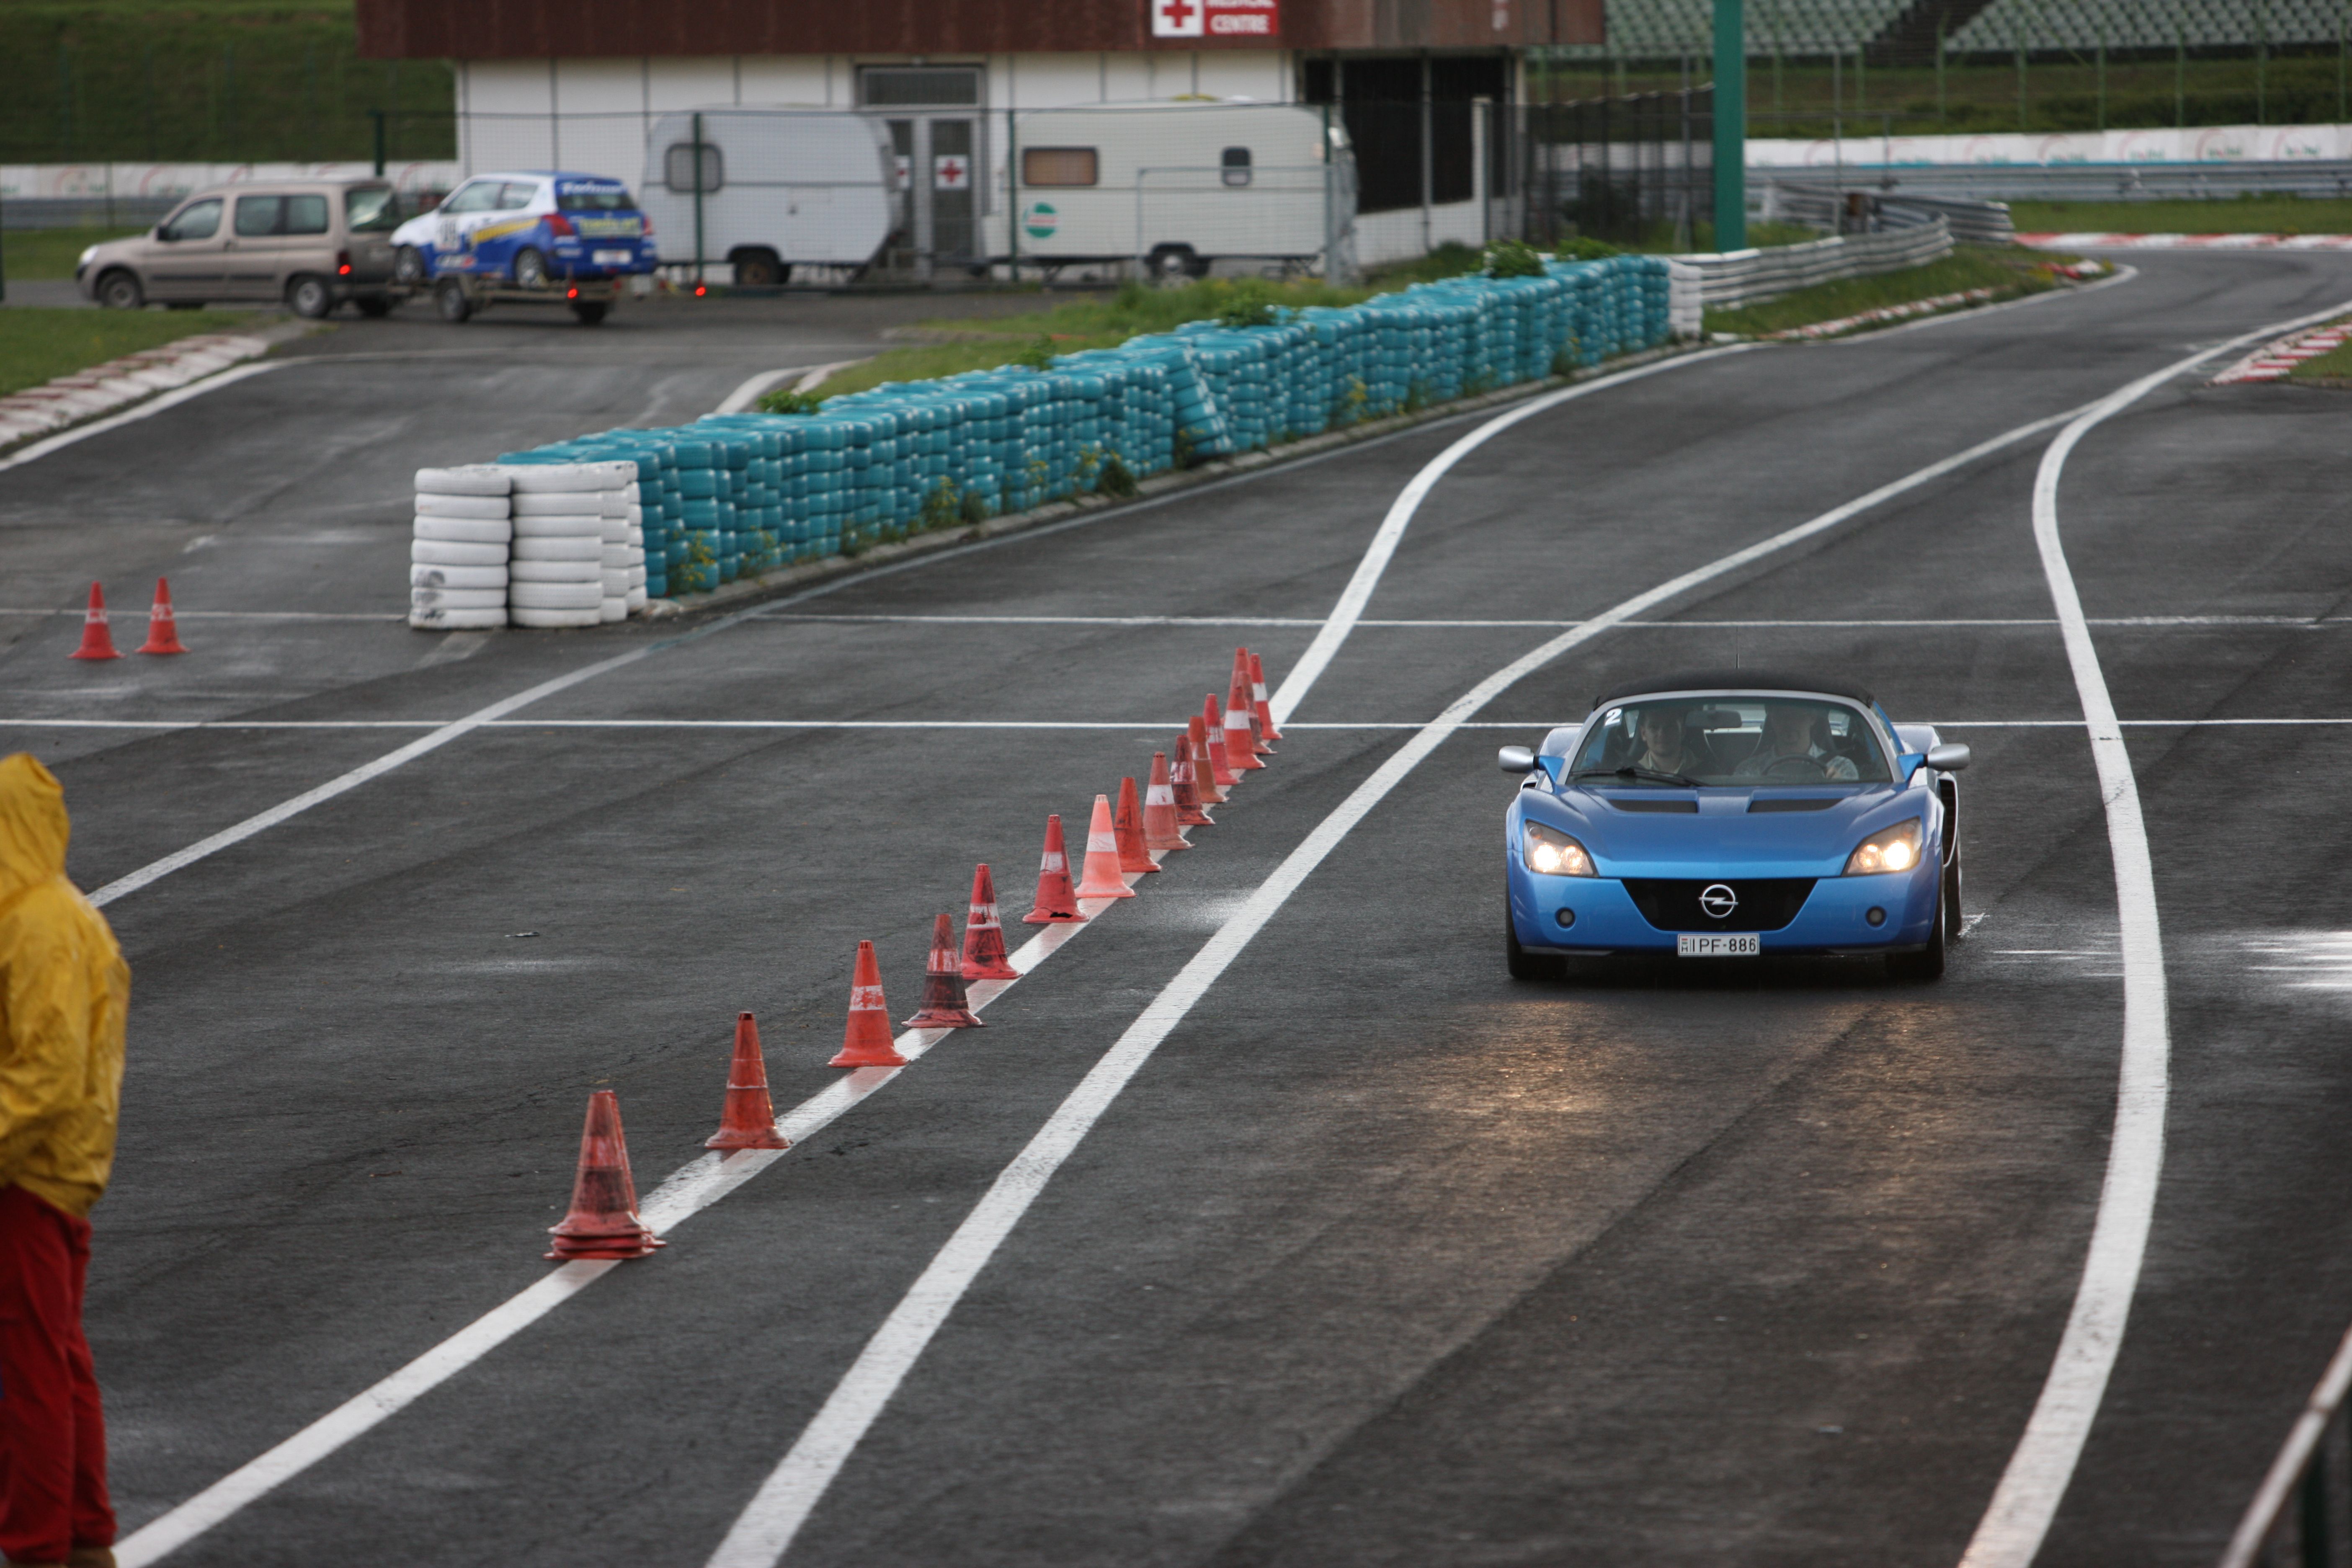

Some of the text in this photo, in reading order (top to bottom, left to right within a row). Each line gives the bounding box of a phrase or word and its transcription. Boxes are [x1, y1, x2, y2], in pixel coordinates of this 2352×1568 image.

[1210, 14, 1270, 34] CENTRE
[1604, 708, 1622, 727] 2
[1692, 938, 1756, 953] IPF-886
